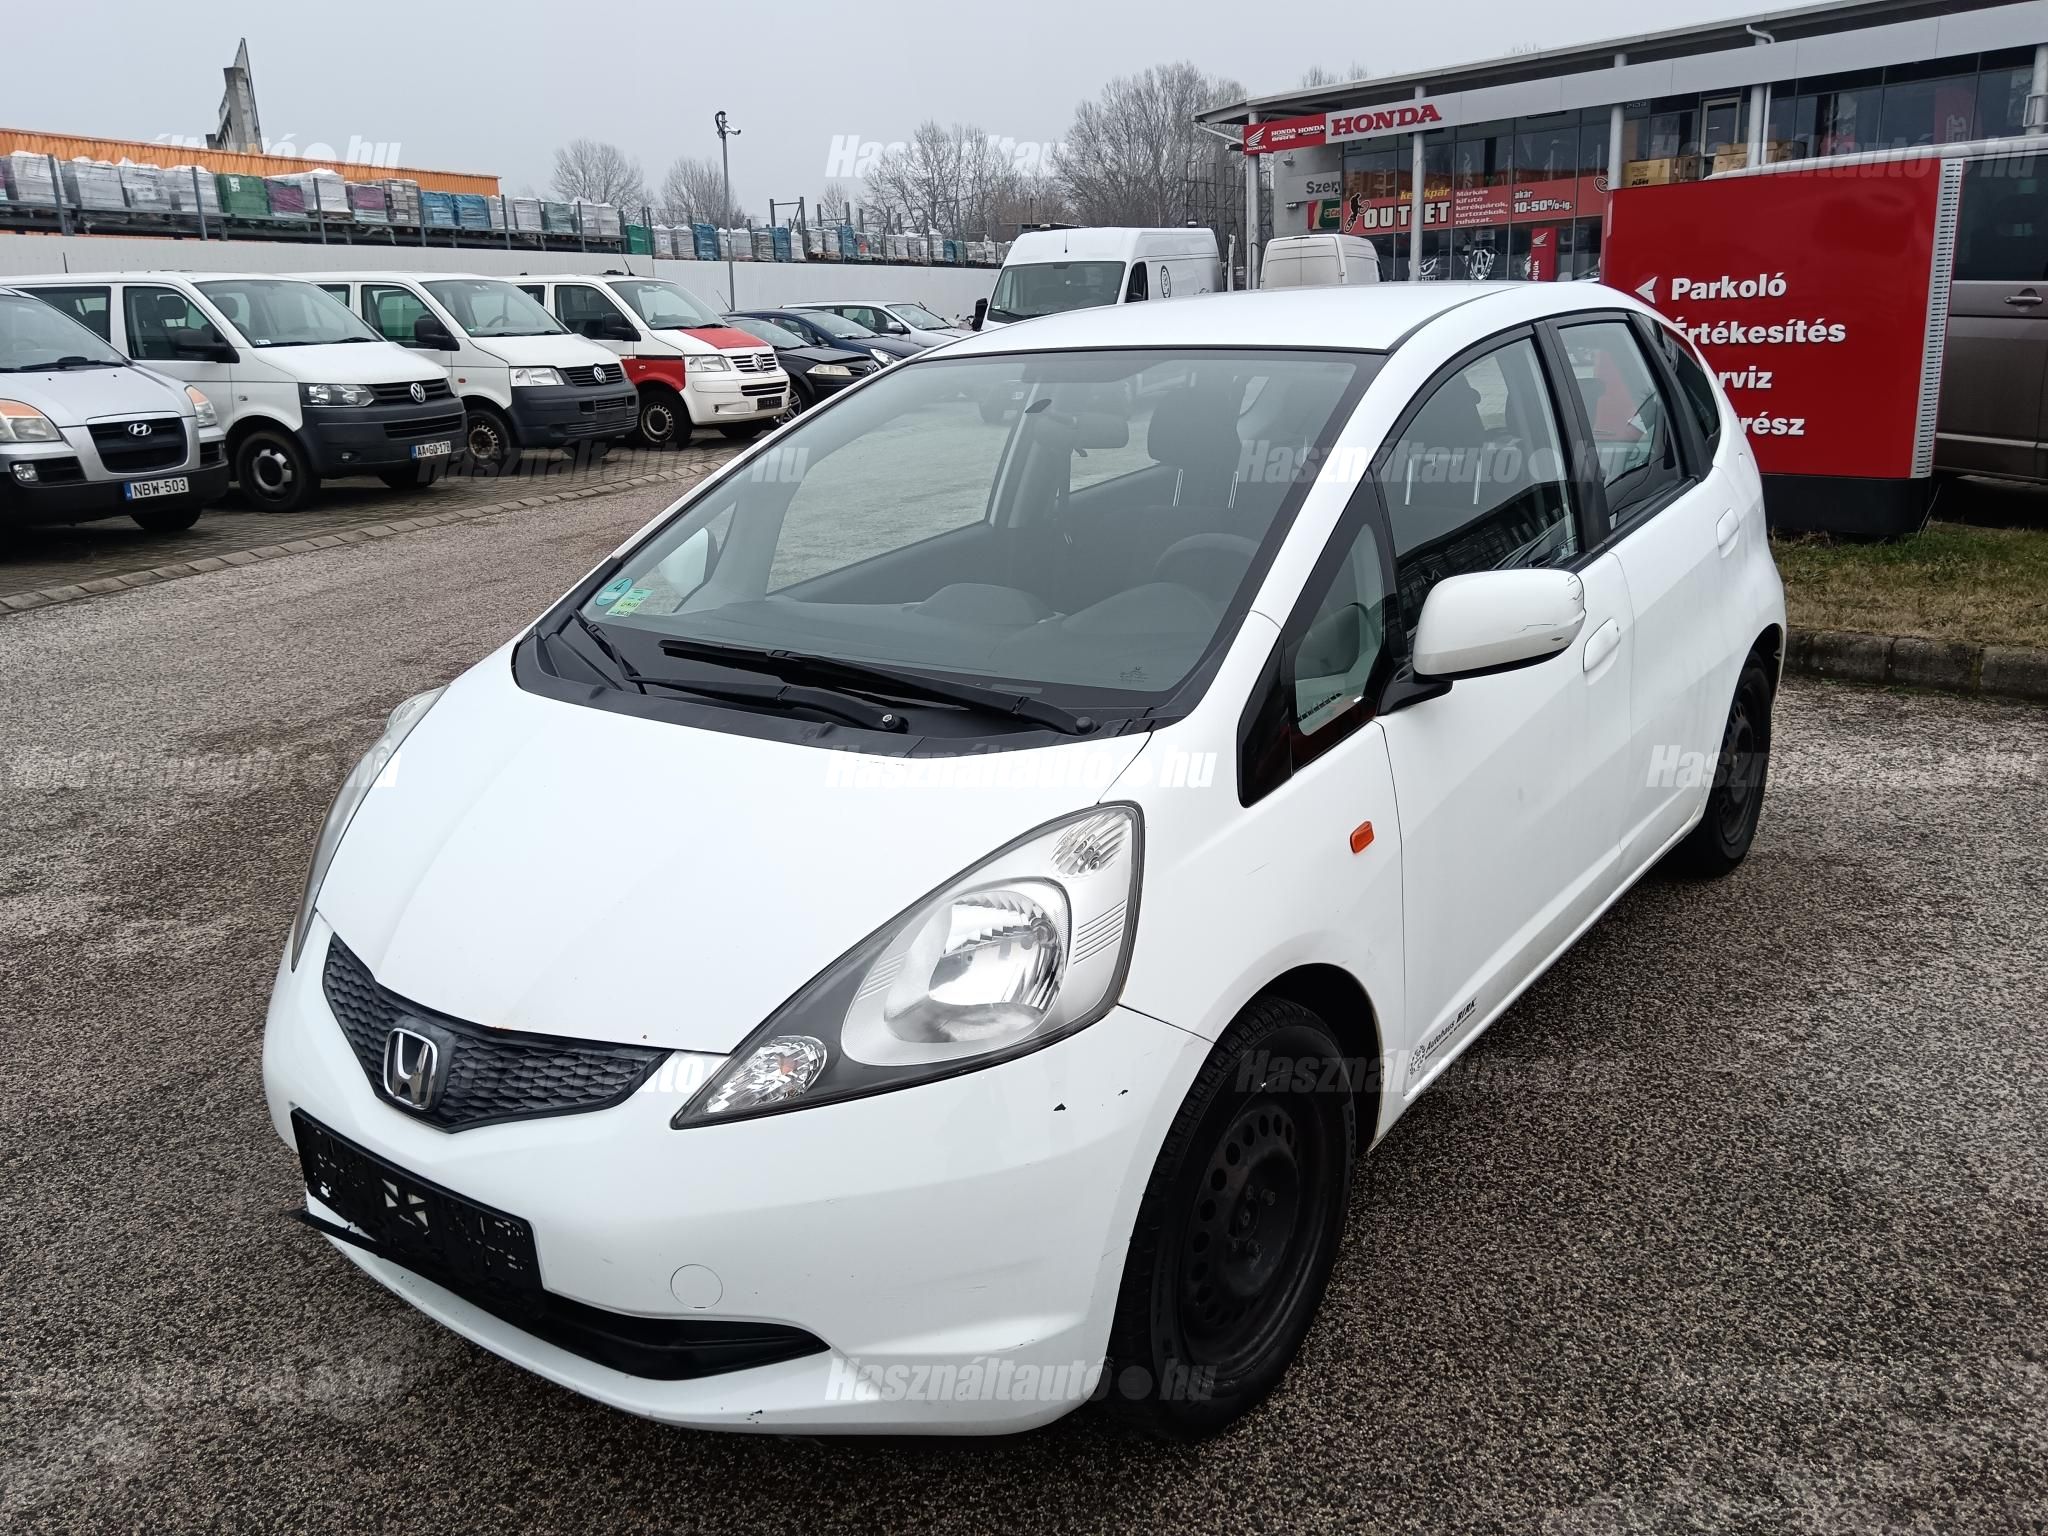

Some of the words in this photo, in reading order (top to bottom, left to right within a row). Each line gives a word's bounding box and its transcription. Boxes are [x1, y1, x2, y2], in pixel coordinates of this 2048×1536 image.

[1298, 124, 1325, 134] HONDA
[1331, 104, 1442, 136] HONDA
[1271, 127, 1297, 137] HONDA
[1400, 187, 1450, 200] kekpár
[1514, 189, 1533, 199] akár
[1363, 201, 1450, 229] OUTET
[1671, 272, 1787, 300] Parkoló
[1718, 366, 1773, 389] rviz
[133, 479, 186, 497] NBW-503
